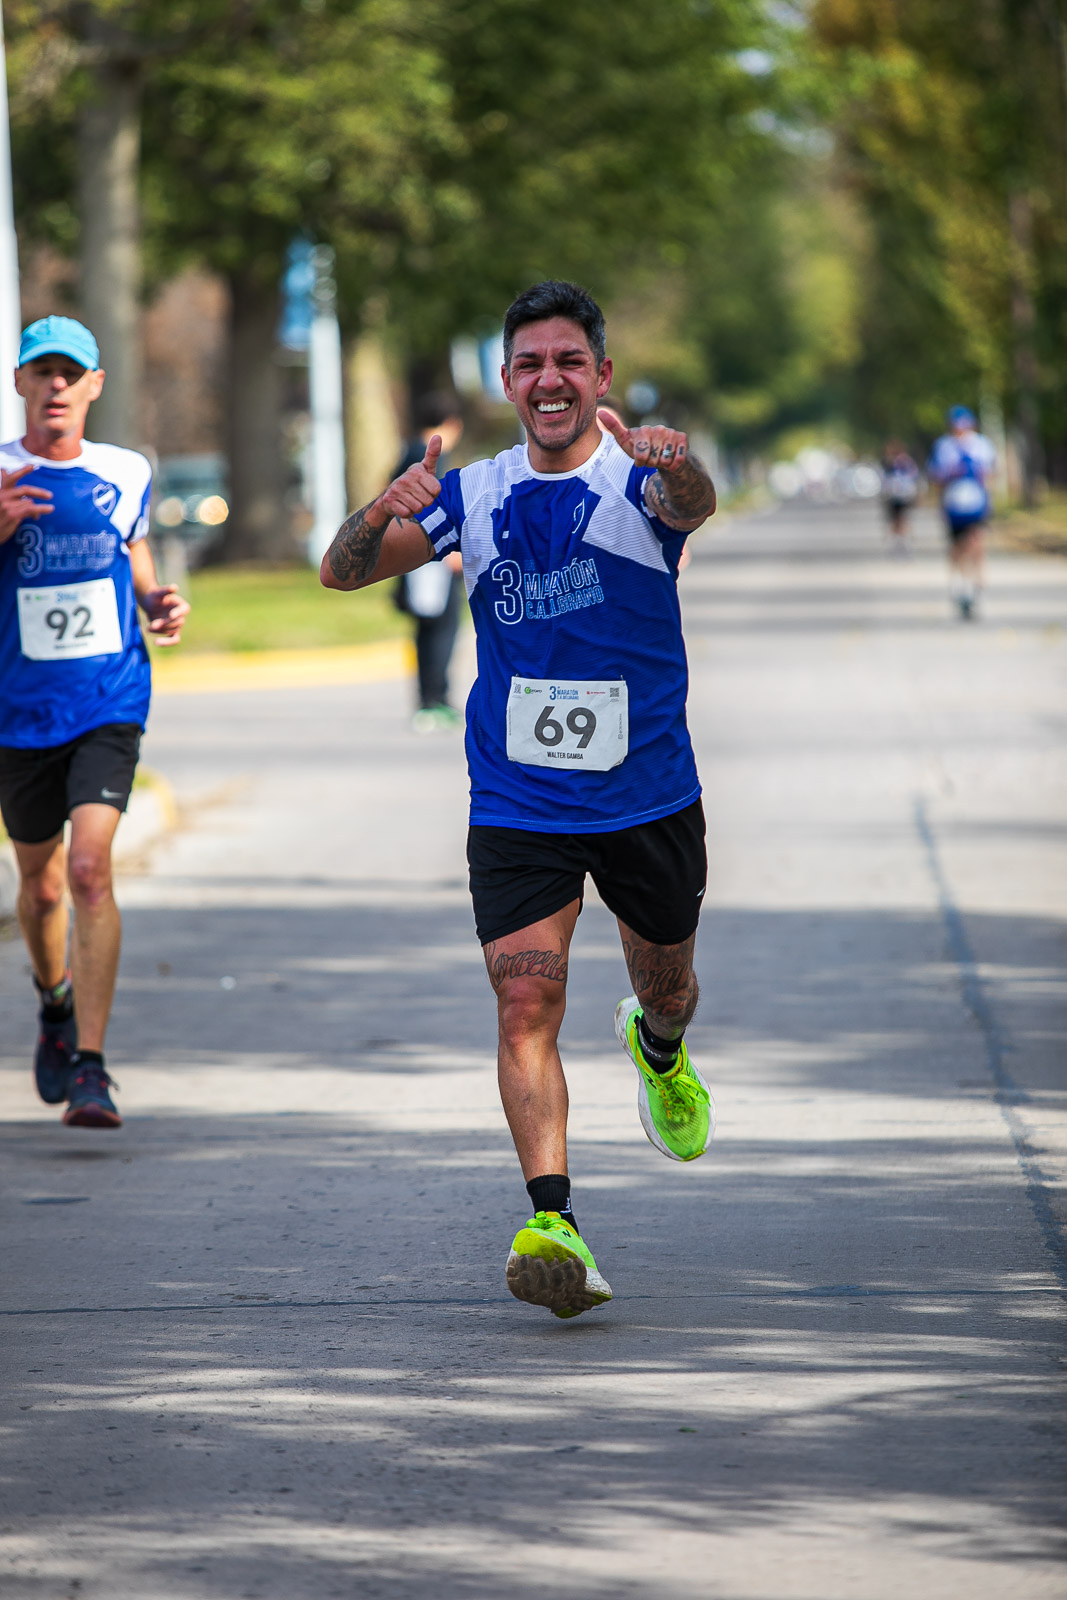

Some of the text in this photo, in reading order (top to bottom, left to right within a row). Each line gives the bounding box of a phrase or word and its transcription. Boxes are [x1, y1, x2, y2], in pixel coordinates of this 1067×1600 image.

[17, 523, 44, 579] 3
[491, 559, 524, 625] 3
[46, 605, 94, 641] 92
[549, 685, 557, 701] 3
[534, 705, 597, 749] 69
[547, 751, 584, 760] WALTER GAMBA
